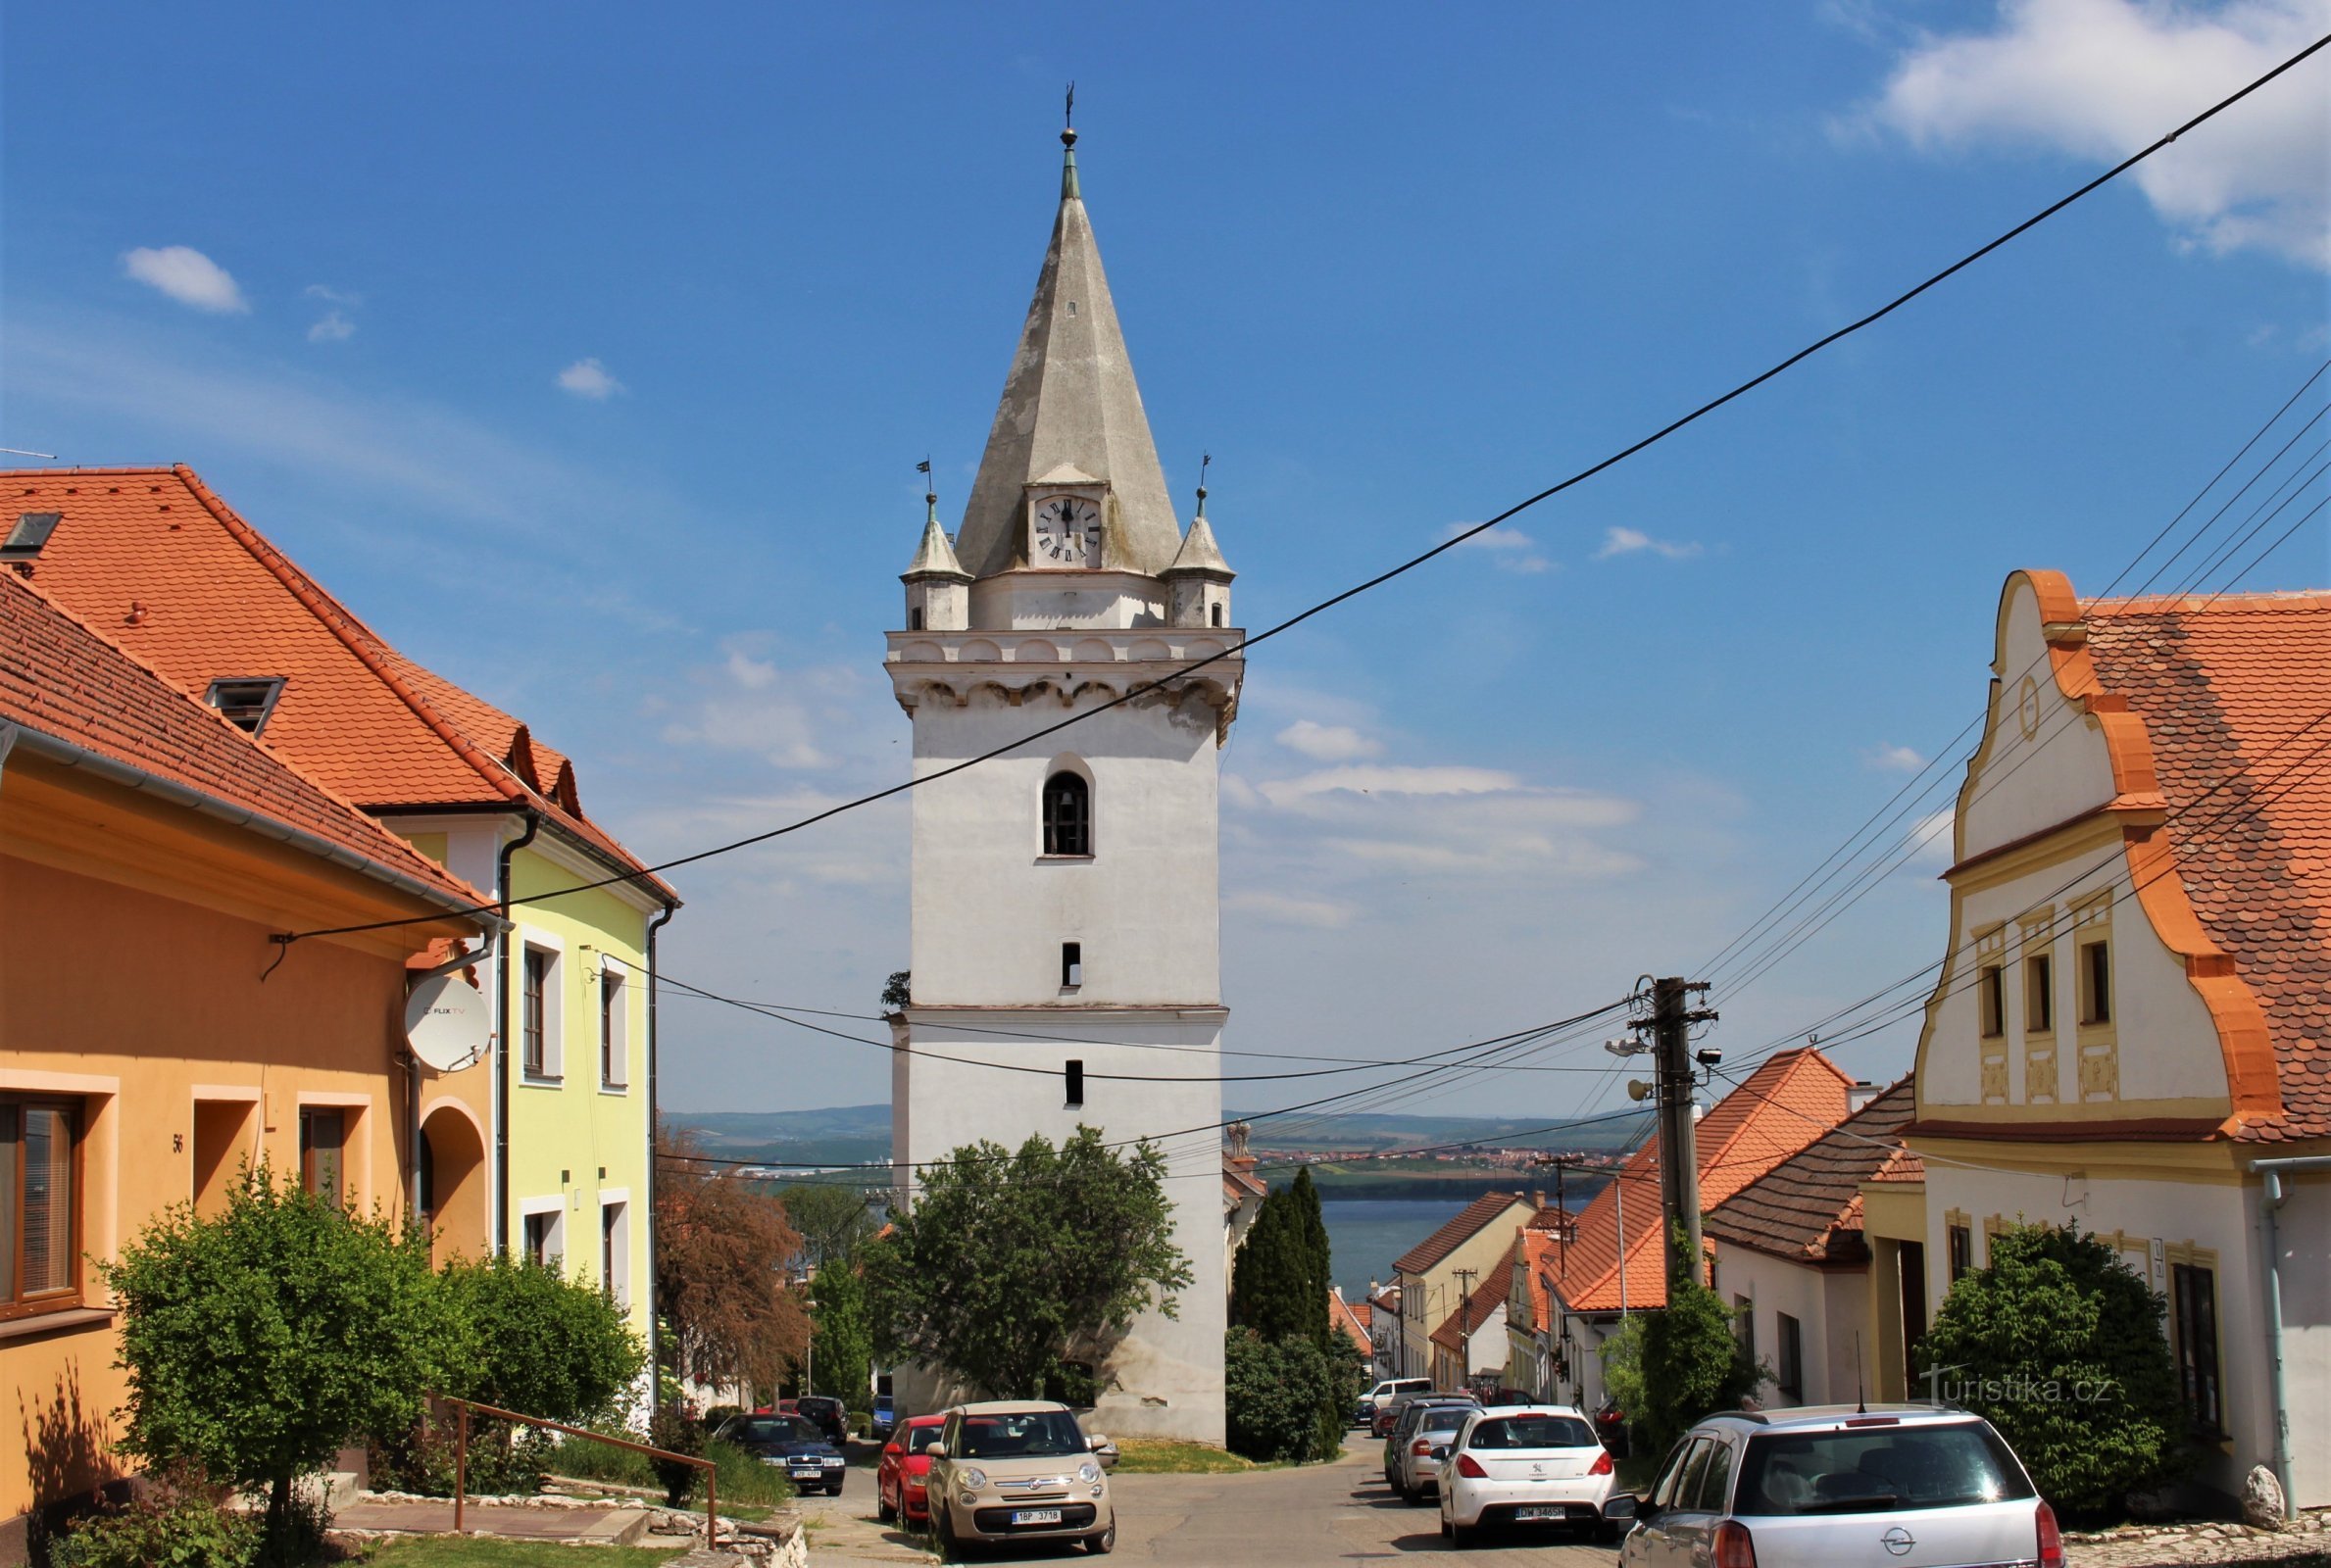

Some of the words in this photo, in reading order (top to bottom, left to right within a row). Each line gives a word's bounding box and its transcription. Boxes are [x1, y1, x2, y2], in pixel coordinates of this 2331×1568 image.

[173, 1133, 183, 1153] 56
[1018, 1512, 1033, 1521] 1BP
[1038, 1511, 1058, 1520] 3718
[1521, 1507, 1534, 1517] DW
